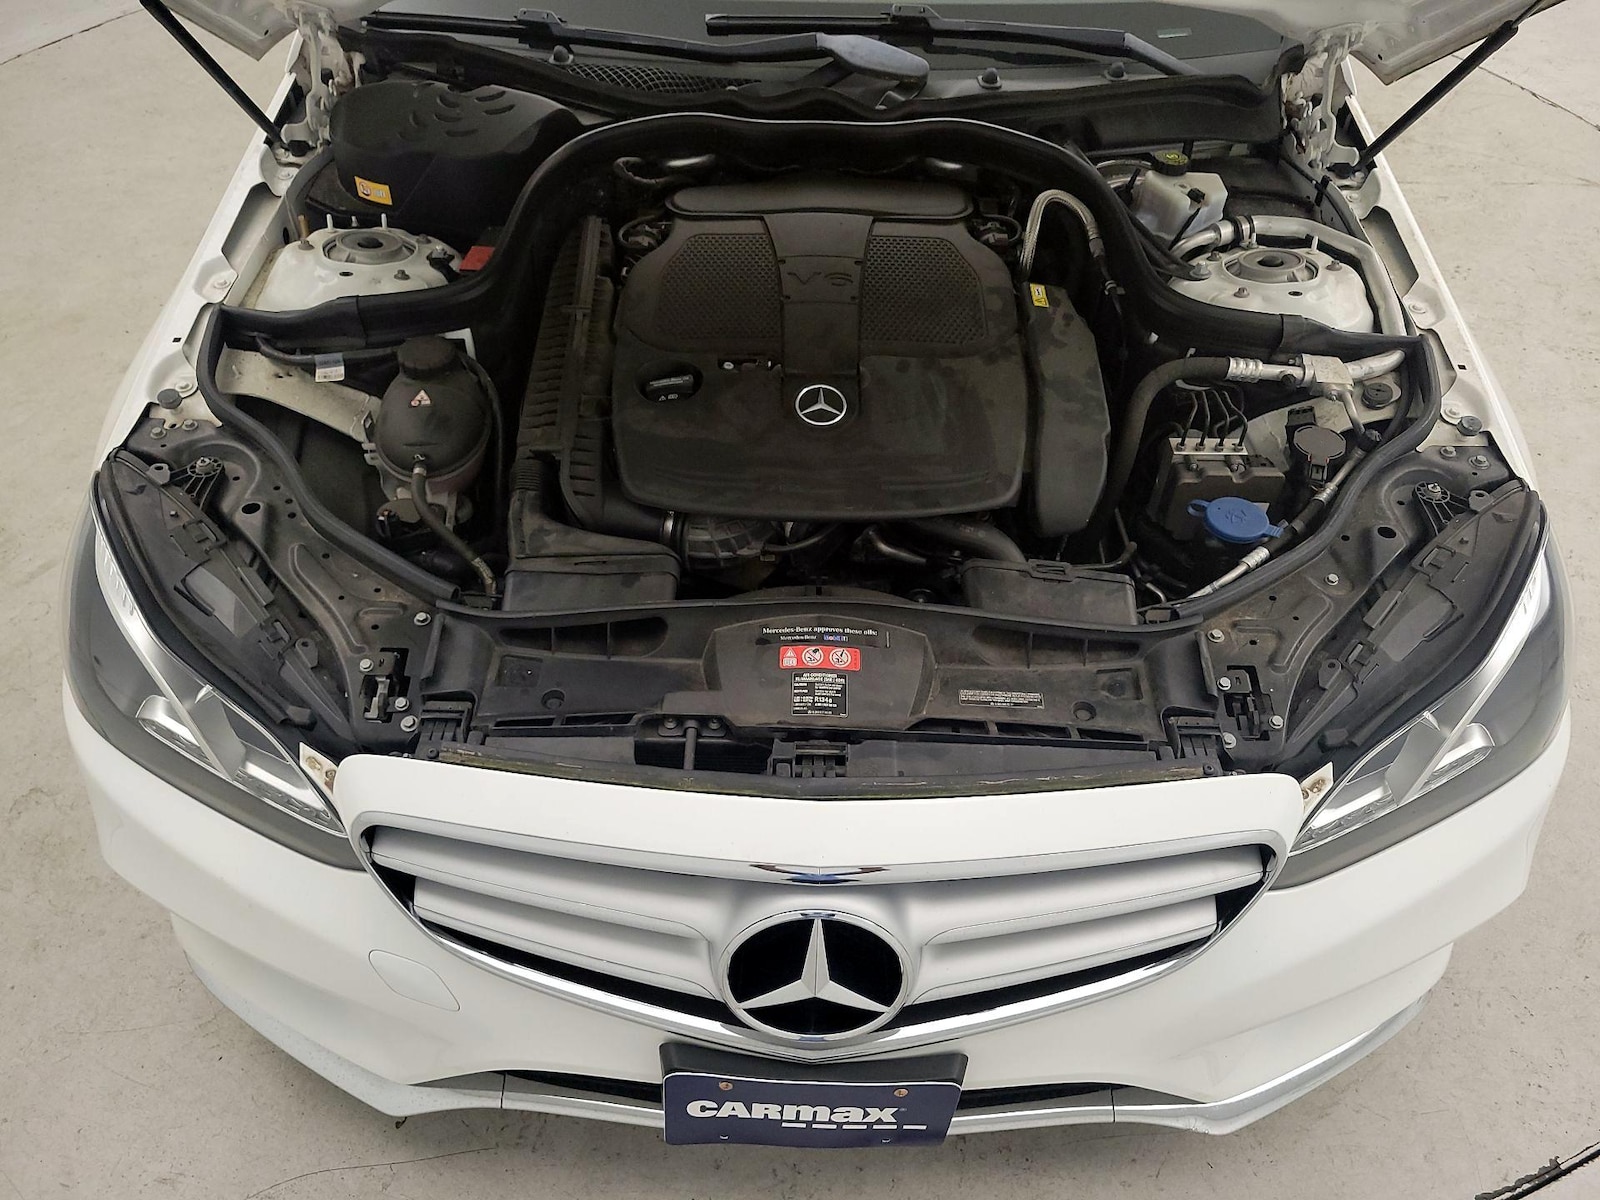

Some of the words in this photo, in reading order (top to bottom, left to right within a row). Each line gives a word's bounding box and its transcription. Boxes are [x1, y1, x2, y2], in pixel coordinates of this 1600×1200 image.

[762, 626, 812, 634] Mercedes-Benz
[813, 626, 844, 634] approves
[844, 627, 862, 635] these
[863, 628, 878, 636] oils:
